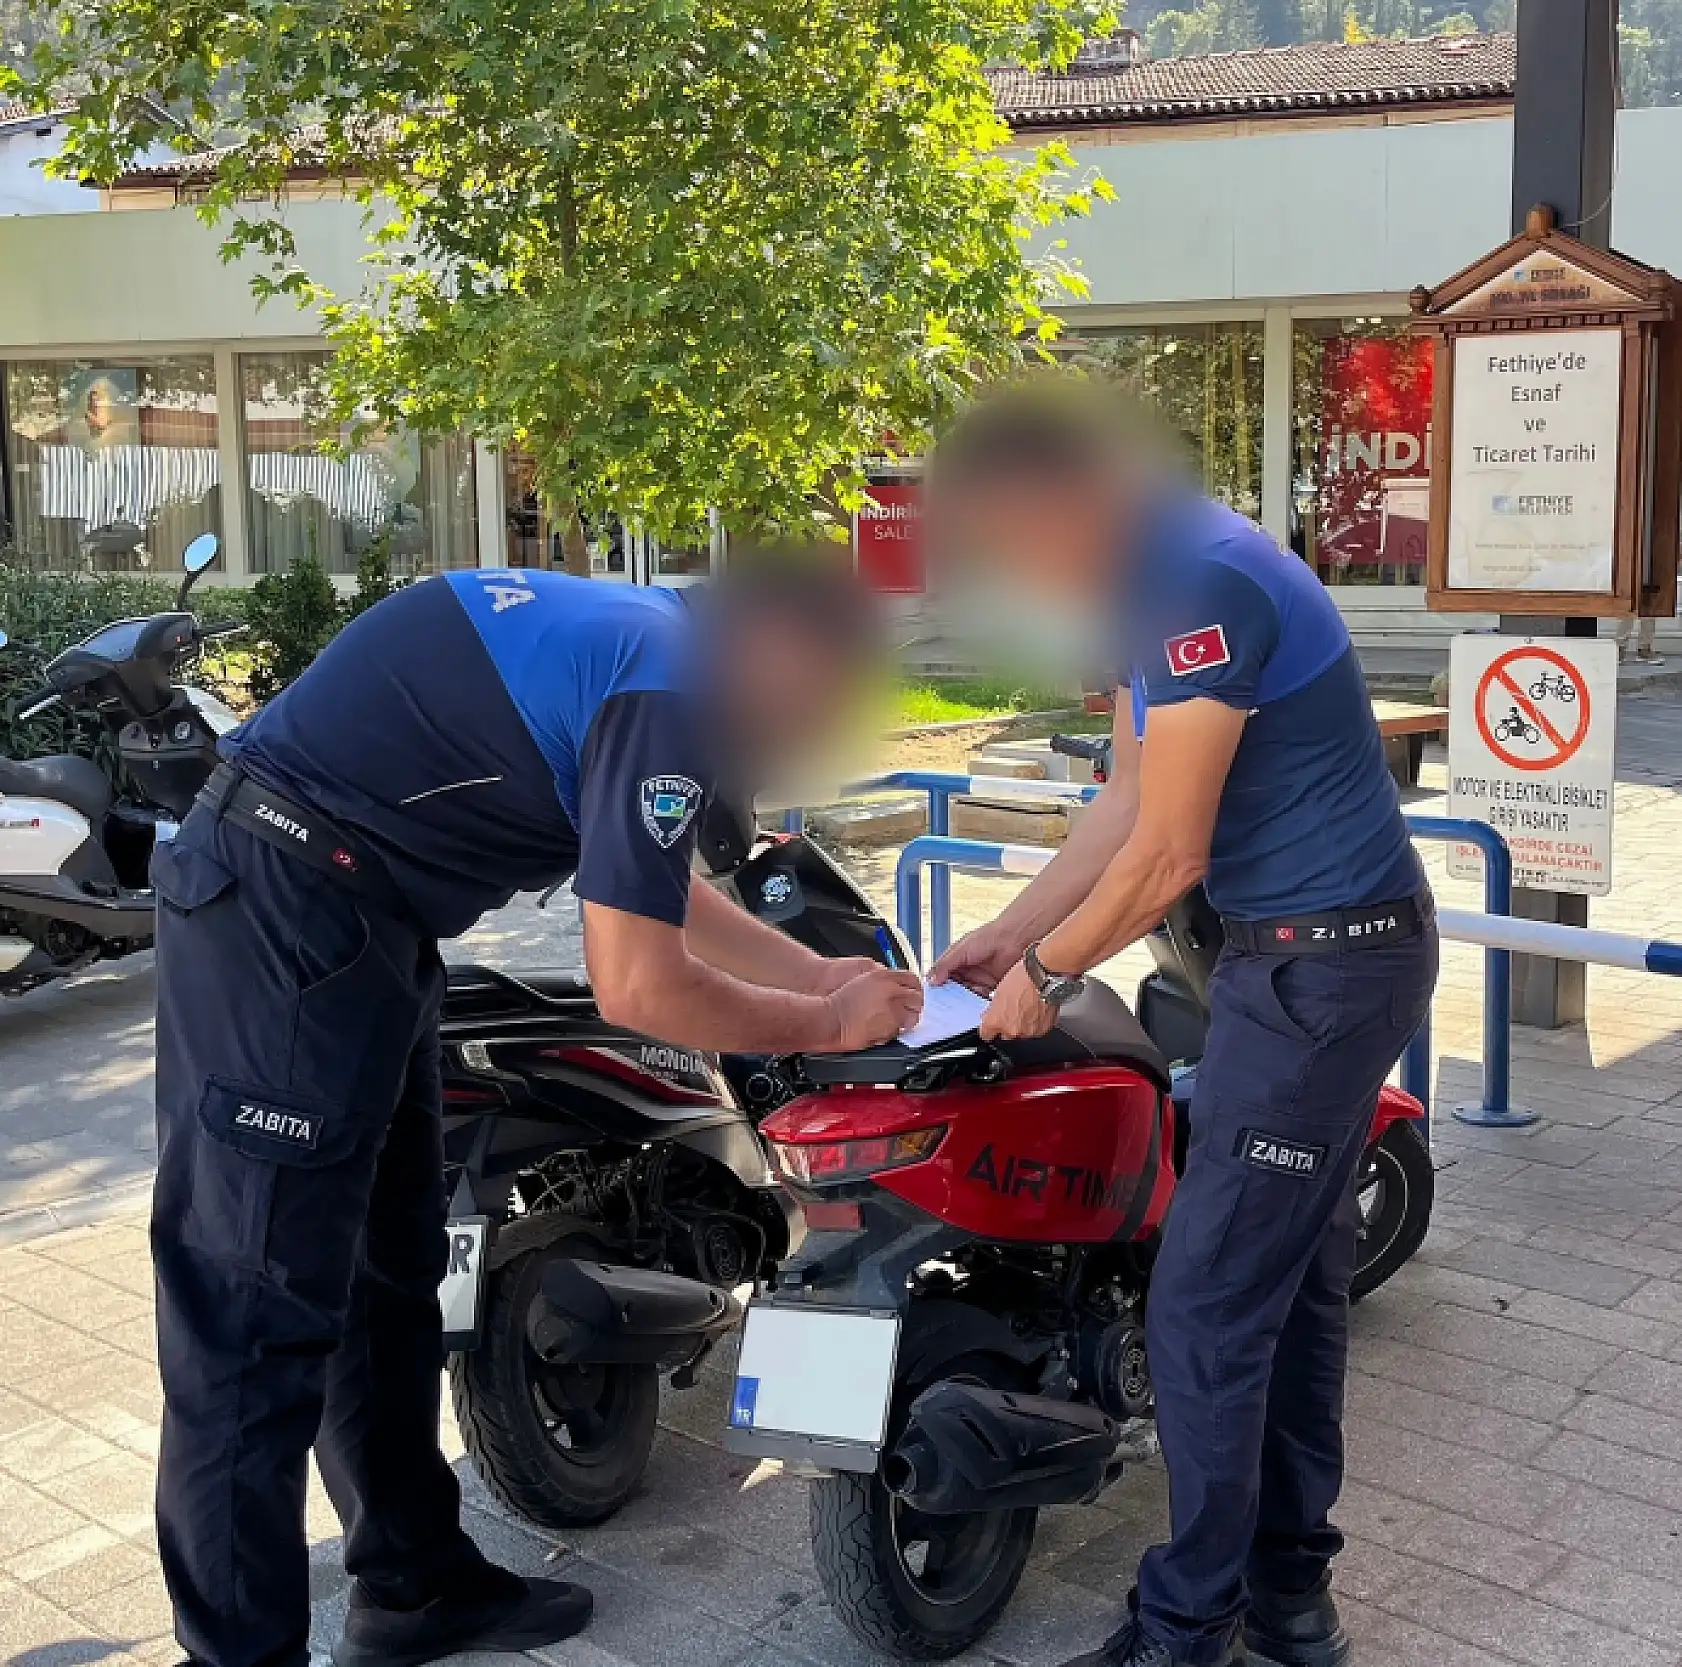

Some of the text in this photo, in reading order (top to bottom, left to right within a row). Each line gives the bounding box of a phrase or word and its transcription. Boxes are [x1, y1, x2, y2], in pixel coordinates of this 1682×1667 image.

[1488, 352, 1586, 375] Fethiye'de
[1511, 382, 1562, 402] Esnaf
[1523, 418, 1547, 432] ve
[1473, 443, 1596, 463] Ticaret Tarihi
[874, 524, 914, 540] SALE
[254, 803, 309, 843] ZABITA
[235, 1105, 311, 1141] ZABITA
[1250, 1139, 1315, 1172] ZABITA
